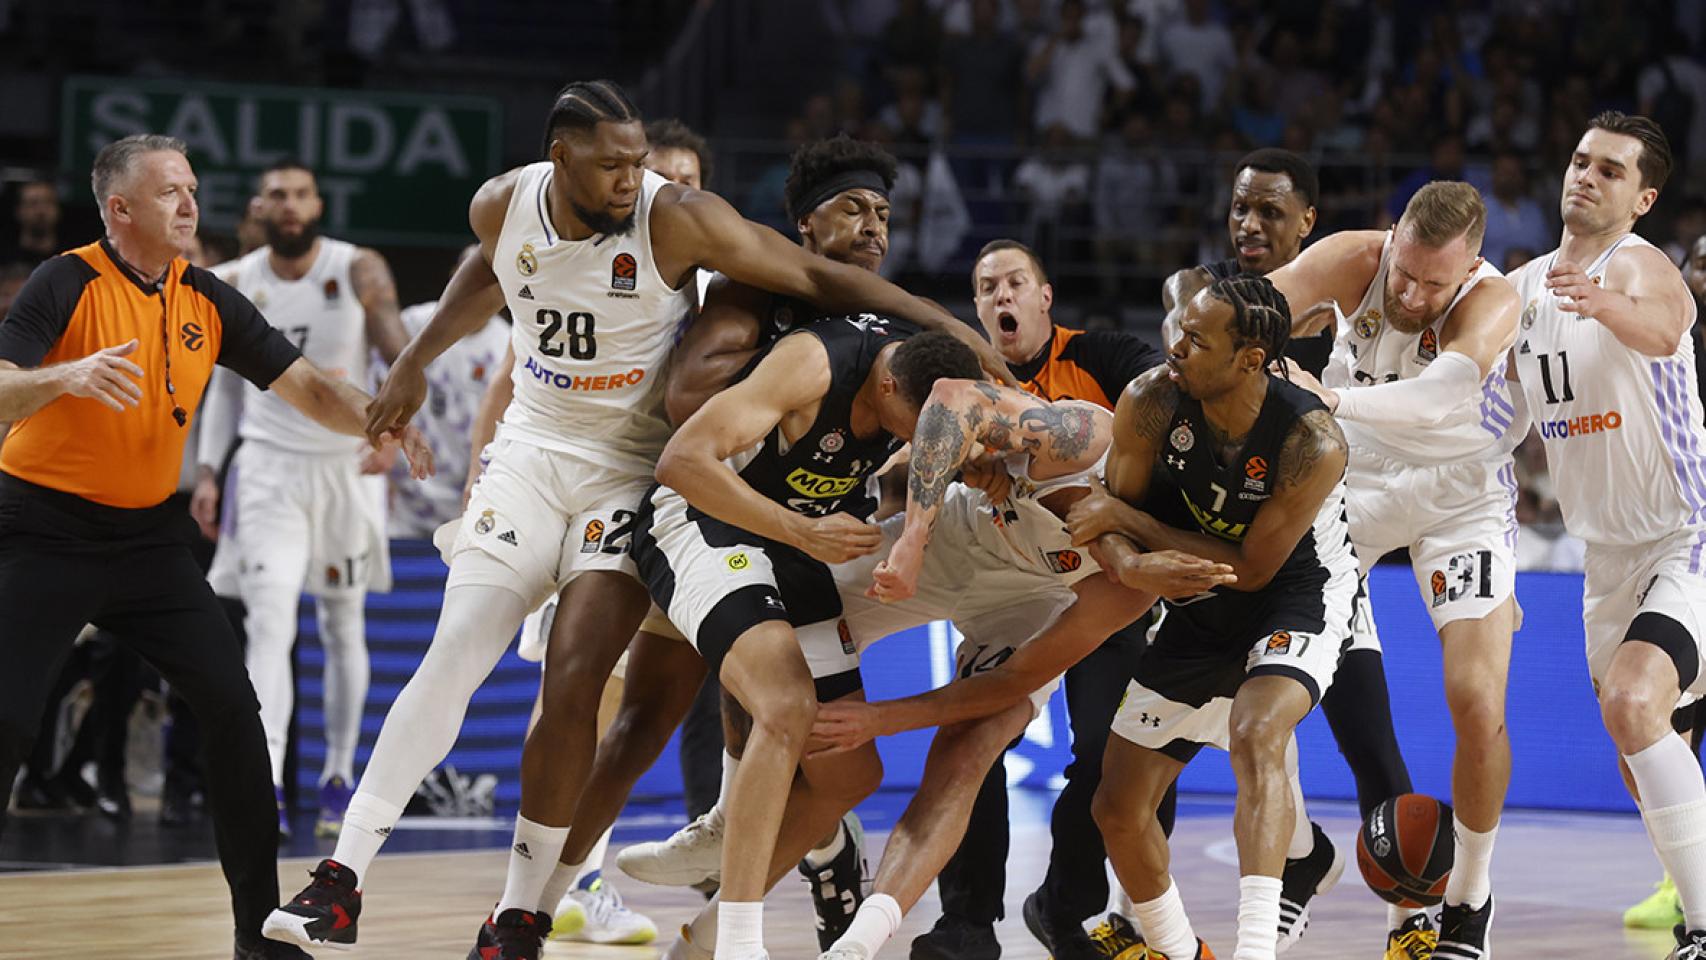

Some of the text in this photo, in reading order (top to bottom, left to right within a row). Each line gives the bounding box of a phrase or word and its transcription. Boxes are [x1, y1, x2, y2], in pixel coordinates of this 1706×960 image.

[89, 90, 469, 178] SALIDA
[536, 309, 597, 360] 28
[524, 356, 645, 391] AUTOHERO
[1537, 351, 1575, 404] 11
[1210, 481, 1227, 512] 7
[1448, 550, 1494, 601] 31
[1296, 635, 1310, 657] 7
